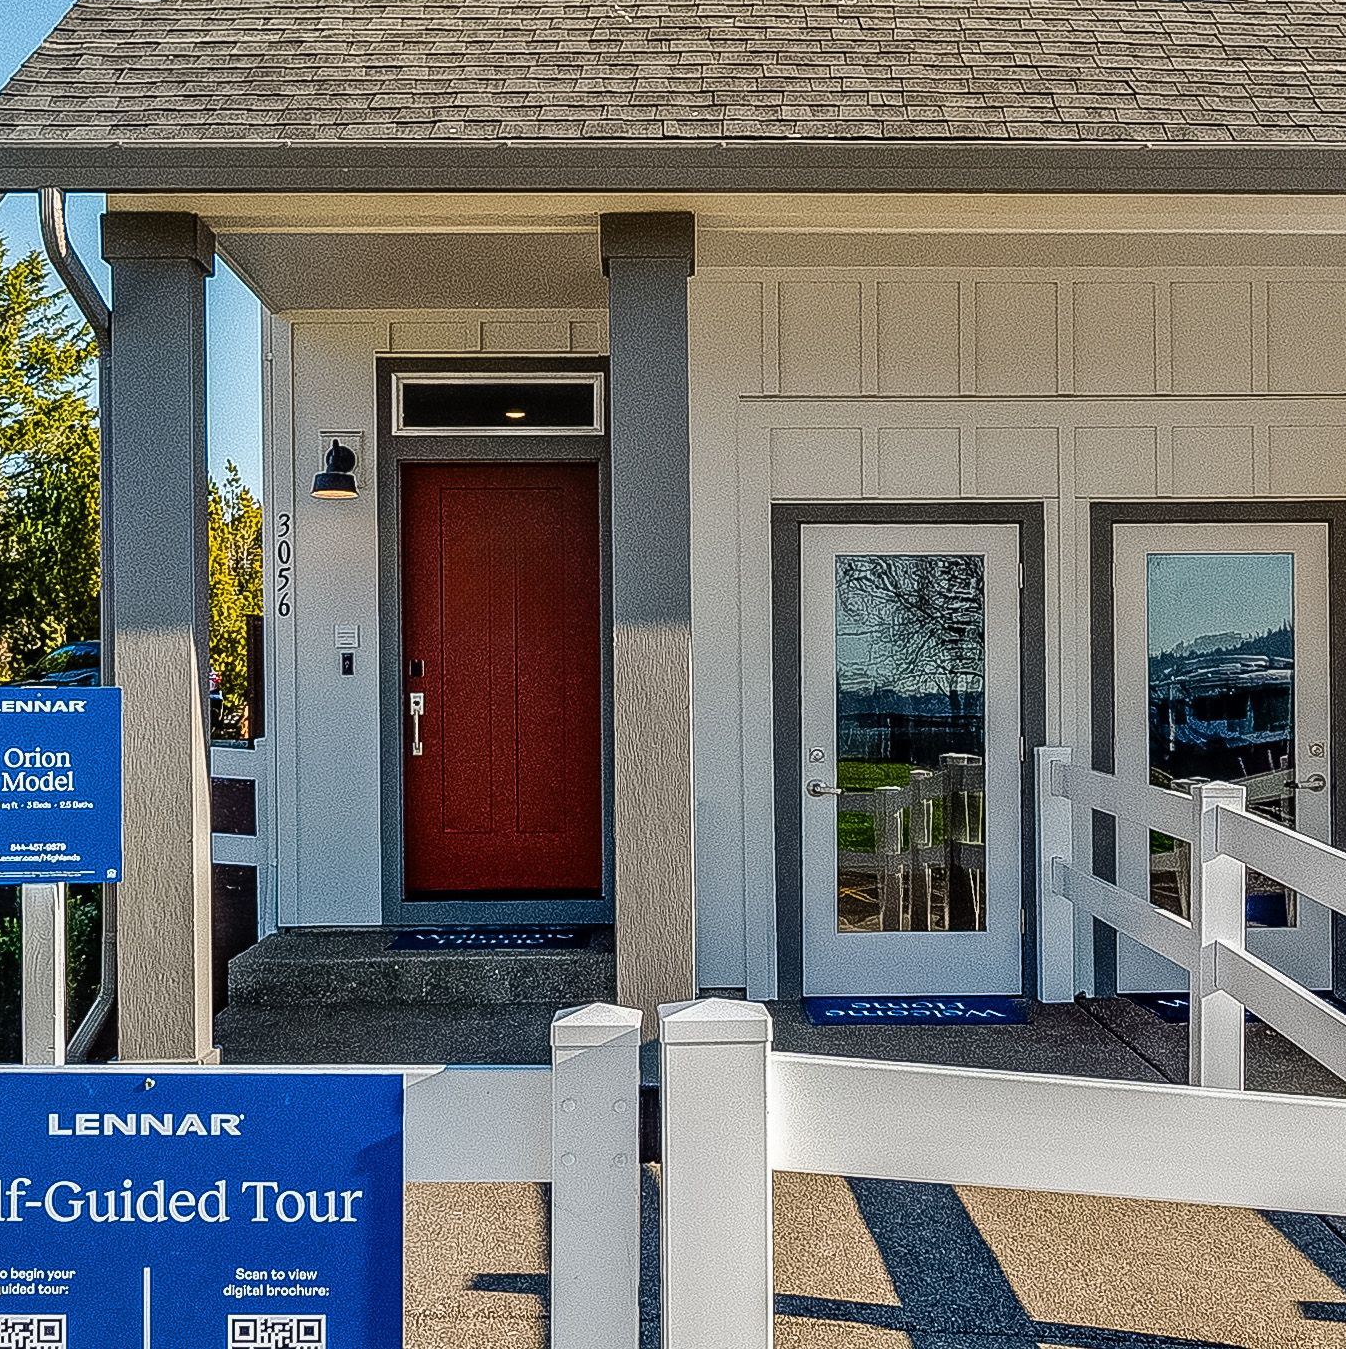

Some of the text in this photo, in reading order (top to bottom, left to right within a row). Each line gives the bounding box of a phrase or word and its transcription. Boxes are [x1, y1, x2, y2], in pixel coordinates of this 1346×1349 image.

[277, 513, 291, 617] 3056
[4, 746, 72, 768] Orion
[1, 770, 75, 792] Model
[48, 1113, 245, 1136] LENNAR
[241, 1181, 363, 1223] Tour
[10, 1267, 44, 1282] begin
[47, 1269, 76, 1282] your
[235, 1267, 318, 1281] Scan to view
[37, 1283, 69, 1296] tour:
[222, 1283, 330, 1299] digital brochure:
